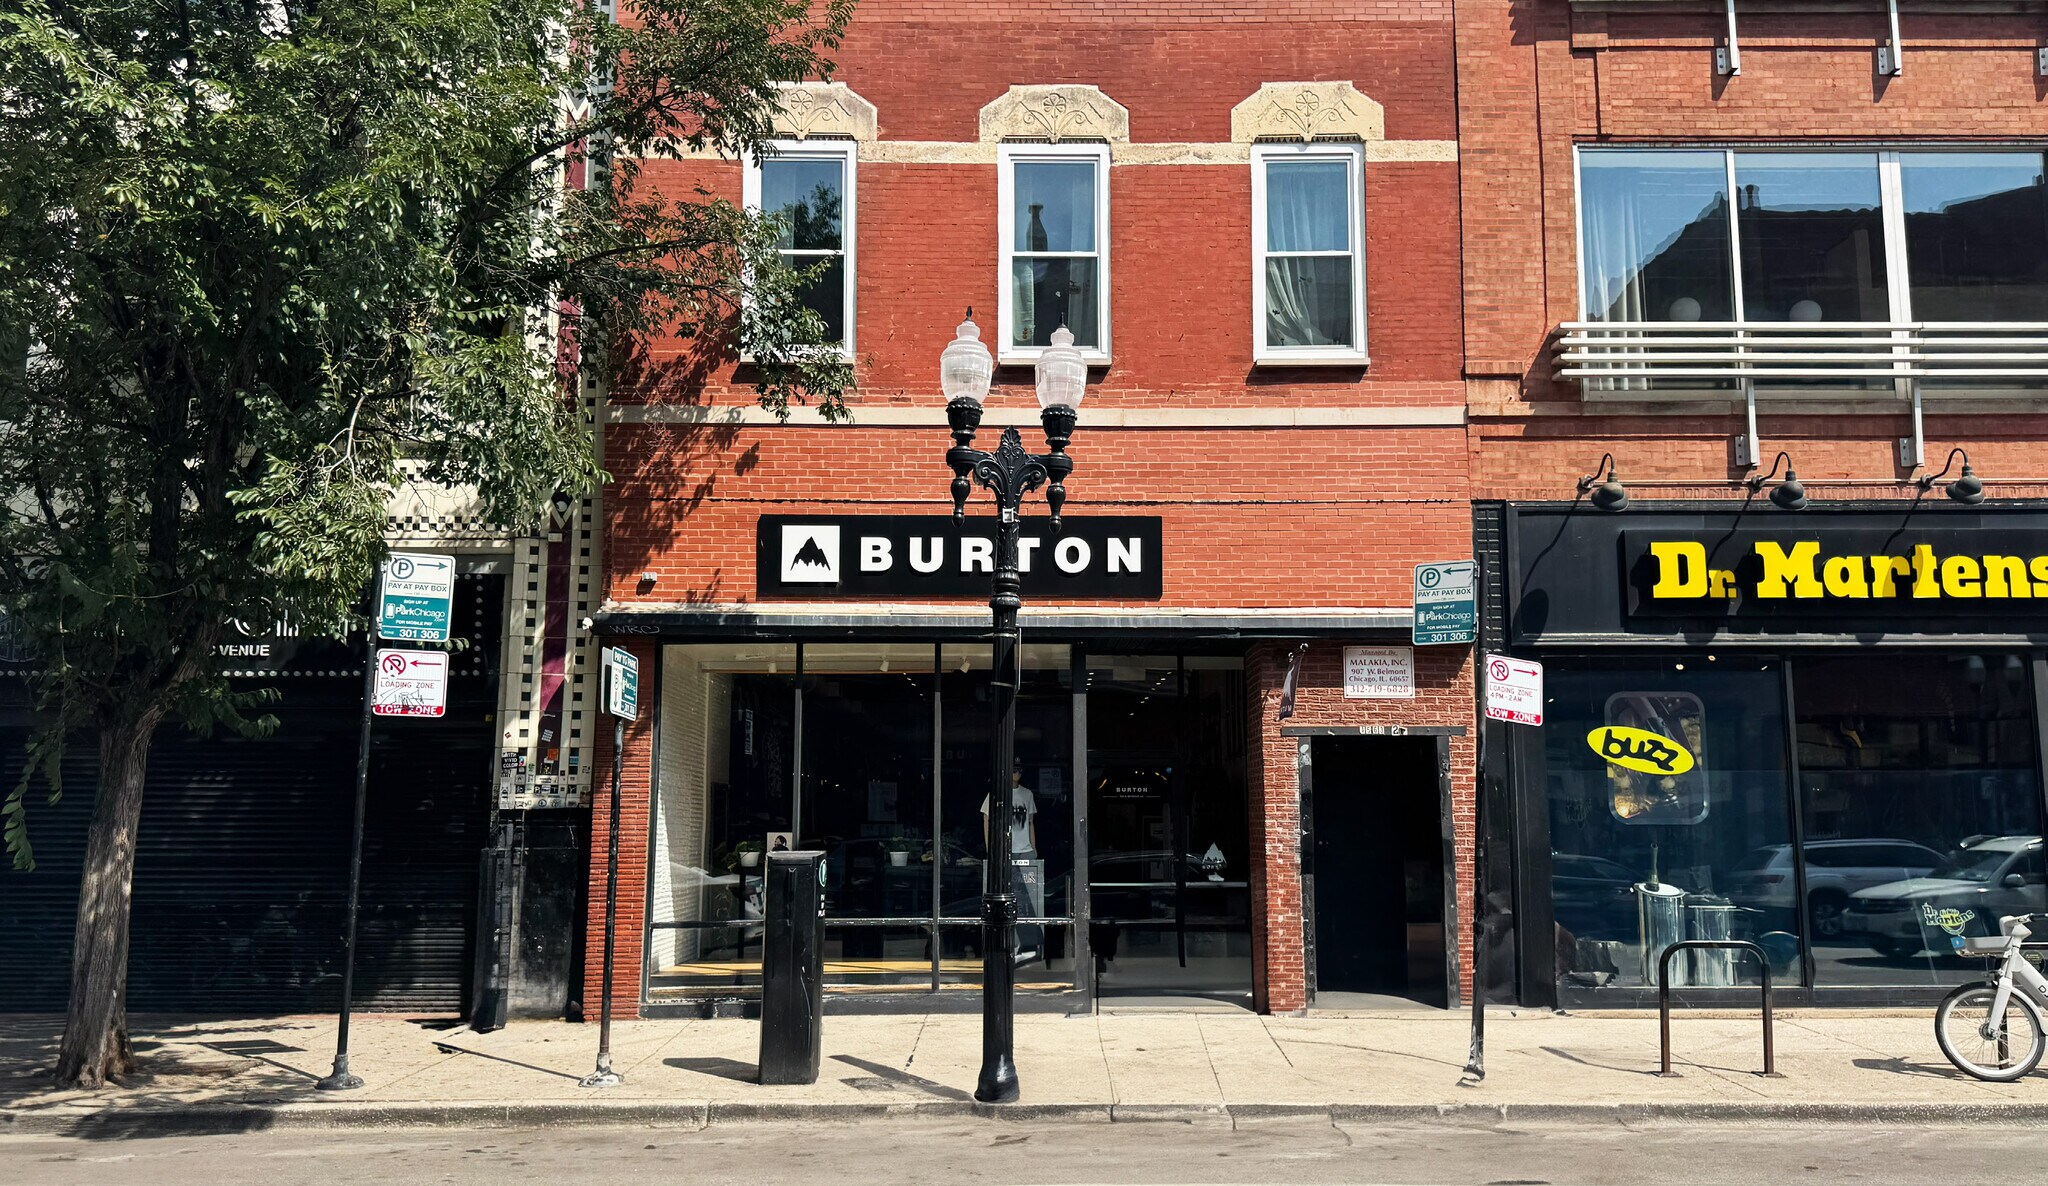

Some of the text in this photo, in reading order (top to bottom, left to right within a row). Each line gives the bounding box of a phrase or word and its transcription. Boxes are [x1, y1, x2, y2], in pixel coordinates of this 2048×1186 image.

[859, 536, 1142, 574] BURTON
[1650, 541, 1738, 598] Dr.
[395, 605, 446, 618] ParkChicago
[1426, 611, 1472, 621] ParkChicago
[399, 629, 417, 638] 301
[420, 630, 440, 639] 306
[1431, 633, 1447, 642] 301
[1449, 632, 1468, 641] 306
[219, 644, 270, 657] VENUE
[1350, 659, 1390, 667] MALAKIA,
[1348, 675, 1378, 683] Chicago,
[1489, 685, 1533, 698] LOADING ZONE
[379, 704, 437, 715] TOW ZONE
[1489, 707, 1537, 723] TOW ZONE
[1602, 728, 1679, 772] buzz
[1925, 910, 1975, 925] Martens
